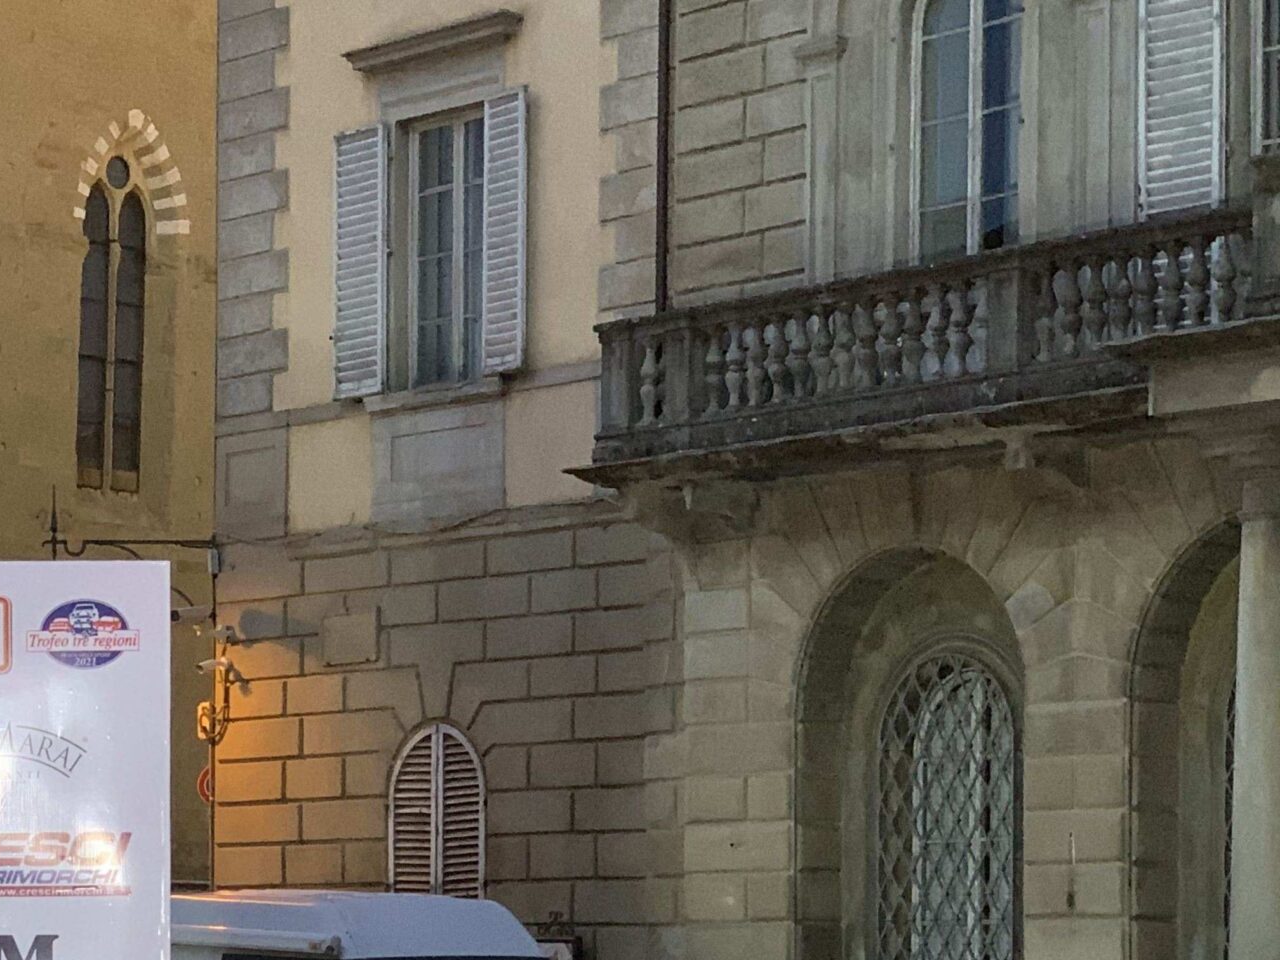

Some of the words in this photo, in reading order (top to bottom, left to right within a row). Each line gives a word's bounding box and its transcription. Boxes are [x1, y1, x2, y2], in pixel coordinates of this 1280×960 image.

[28, 633, 70, 649] Trofeo
[92, 633, 138, 650] regioni
[75, 657, 97, 667] 2021
